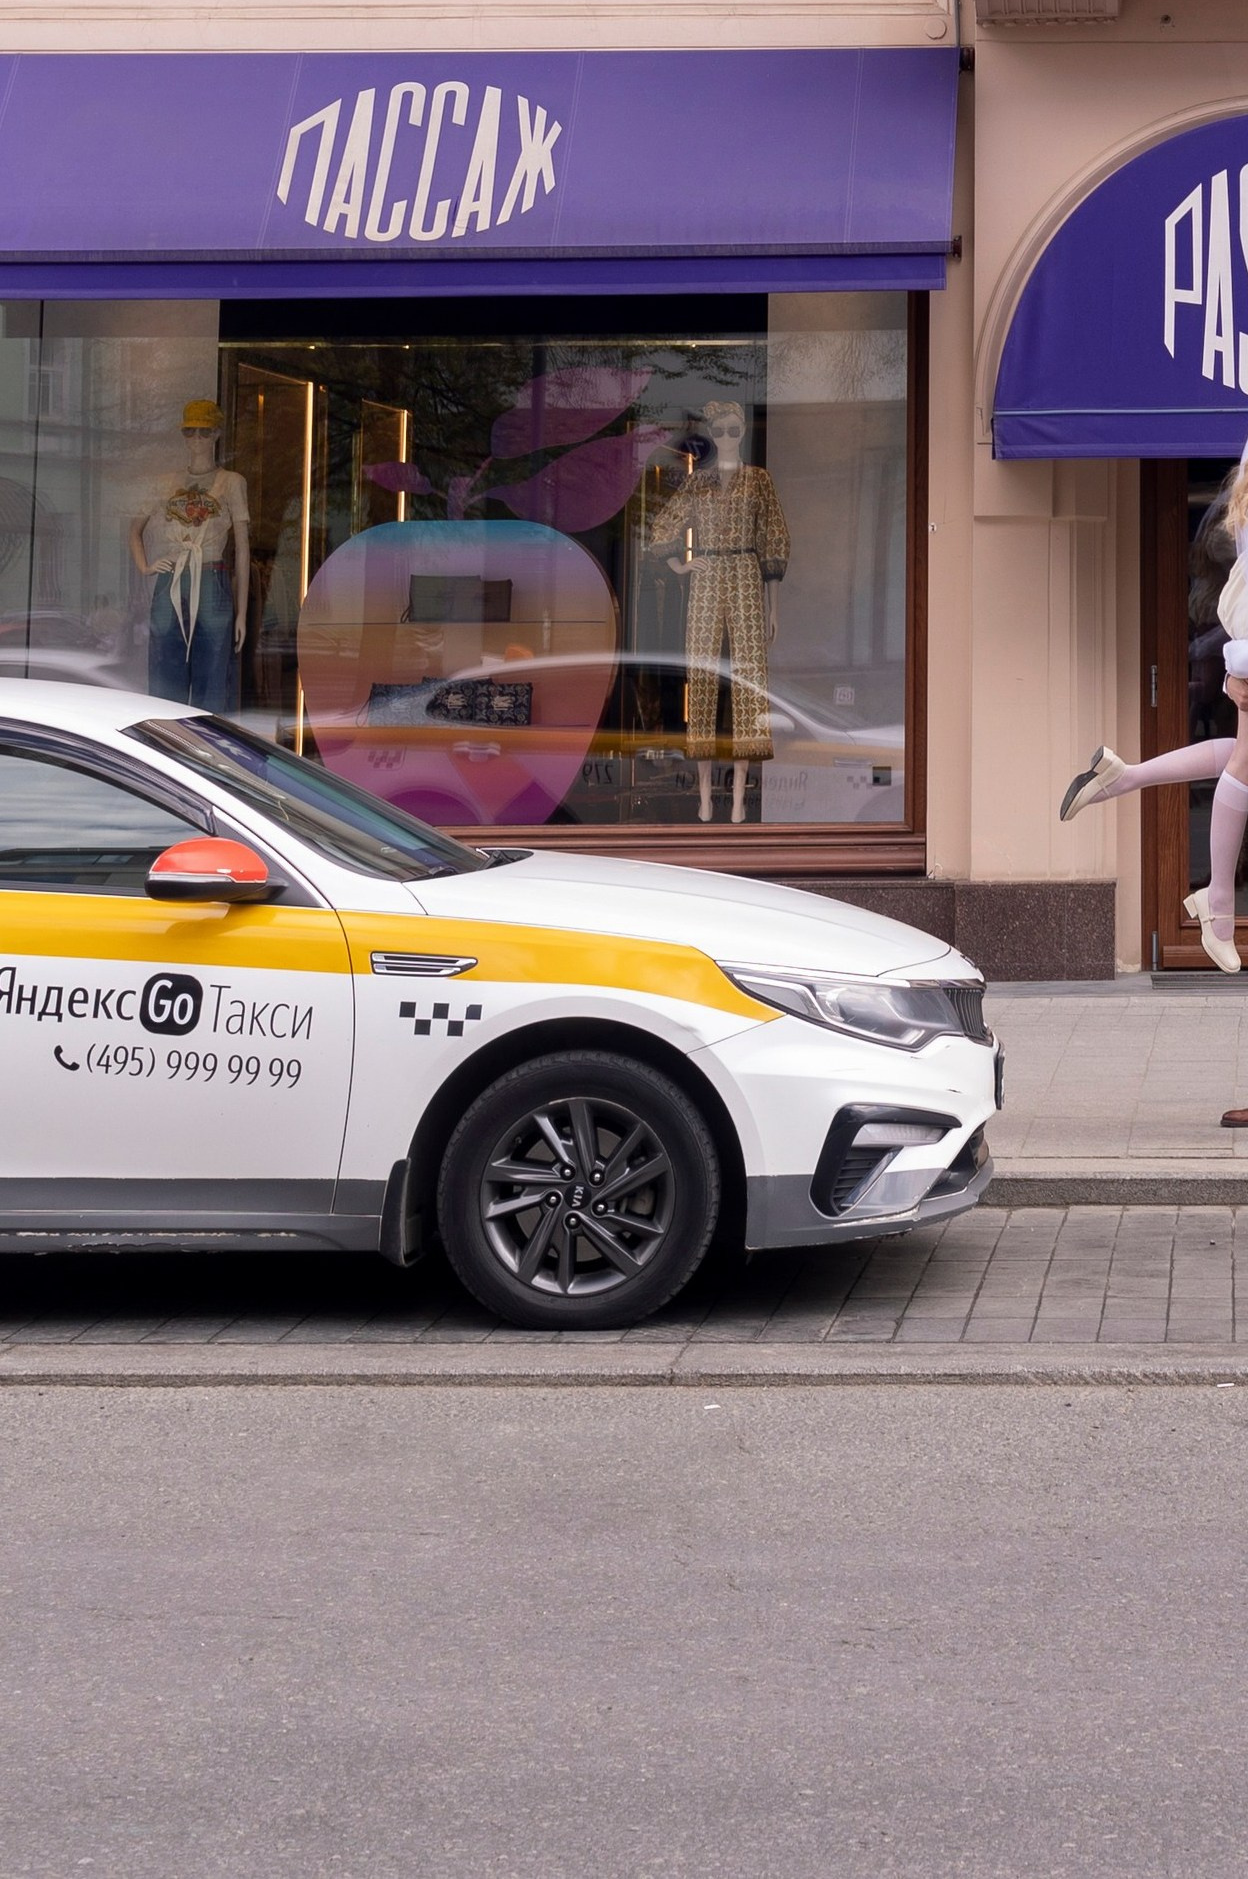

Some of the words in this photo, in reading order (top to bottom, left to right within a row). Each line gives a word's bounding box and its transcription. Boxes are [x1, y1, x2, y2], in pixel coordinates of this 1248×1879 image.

[277, 81, 562, 242] ПАССАЖ
[0, 966, 136, 1023] Яндекс
[148, 979, 195, 1025] Go
[209, 984, 314, 1040] Такси
[86, 1043, 156, 1077] (495)
[166, 1050, 218, 1082] 999
[227, 1054, 262, 1086] 99
[268, 1058, 302, 1088] 99
[572, 1185, 585, 1208] KIA
